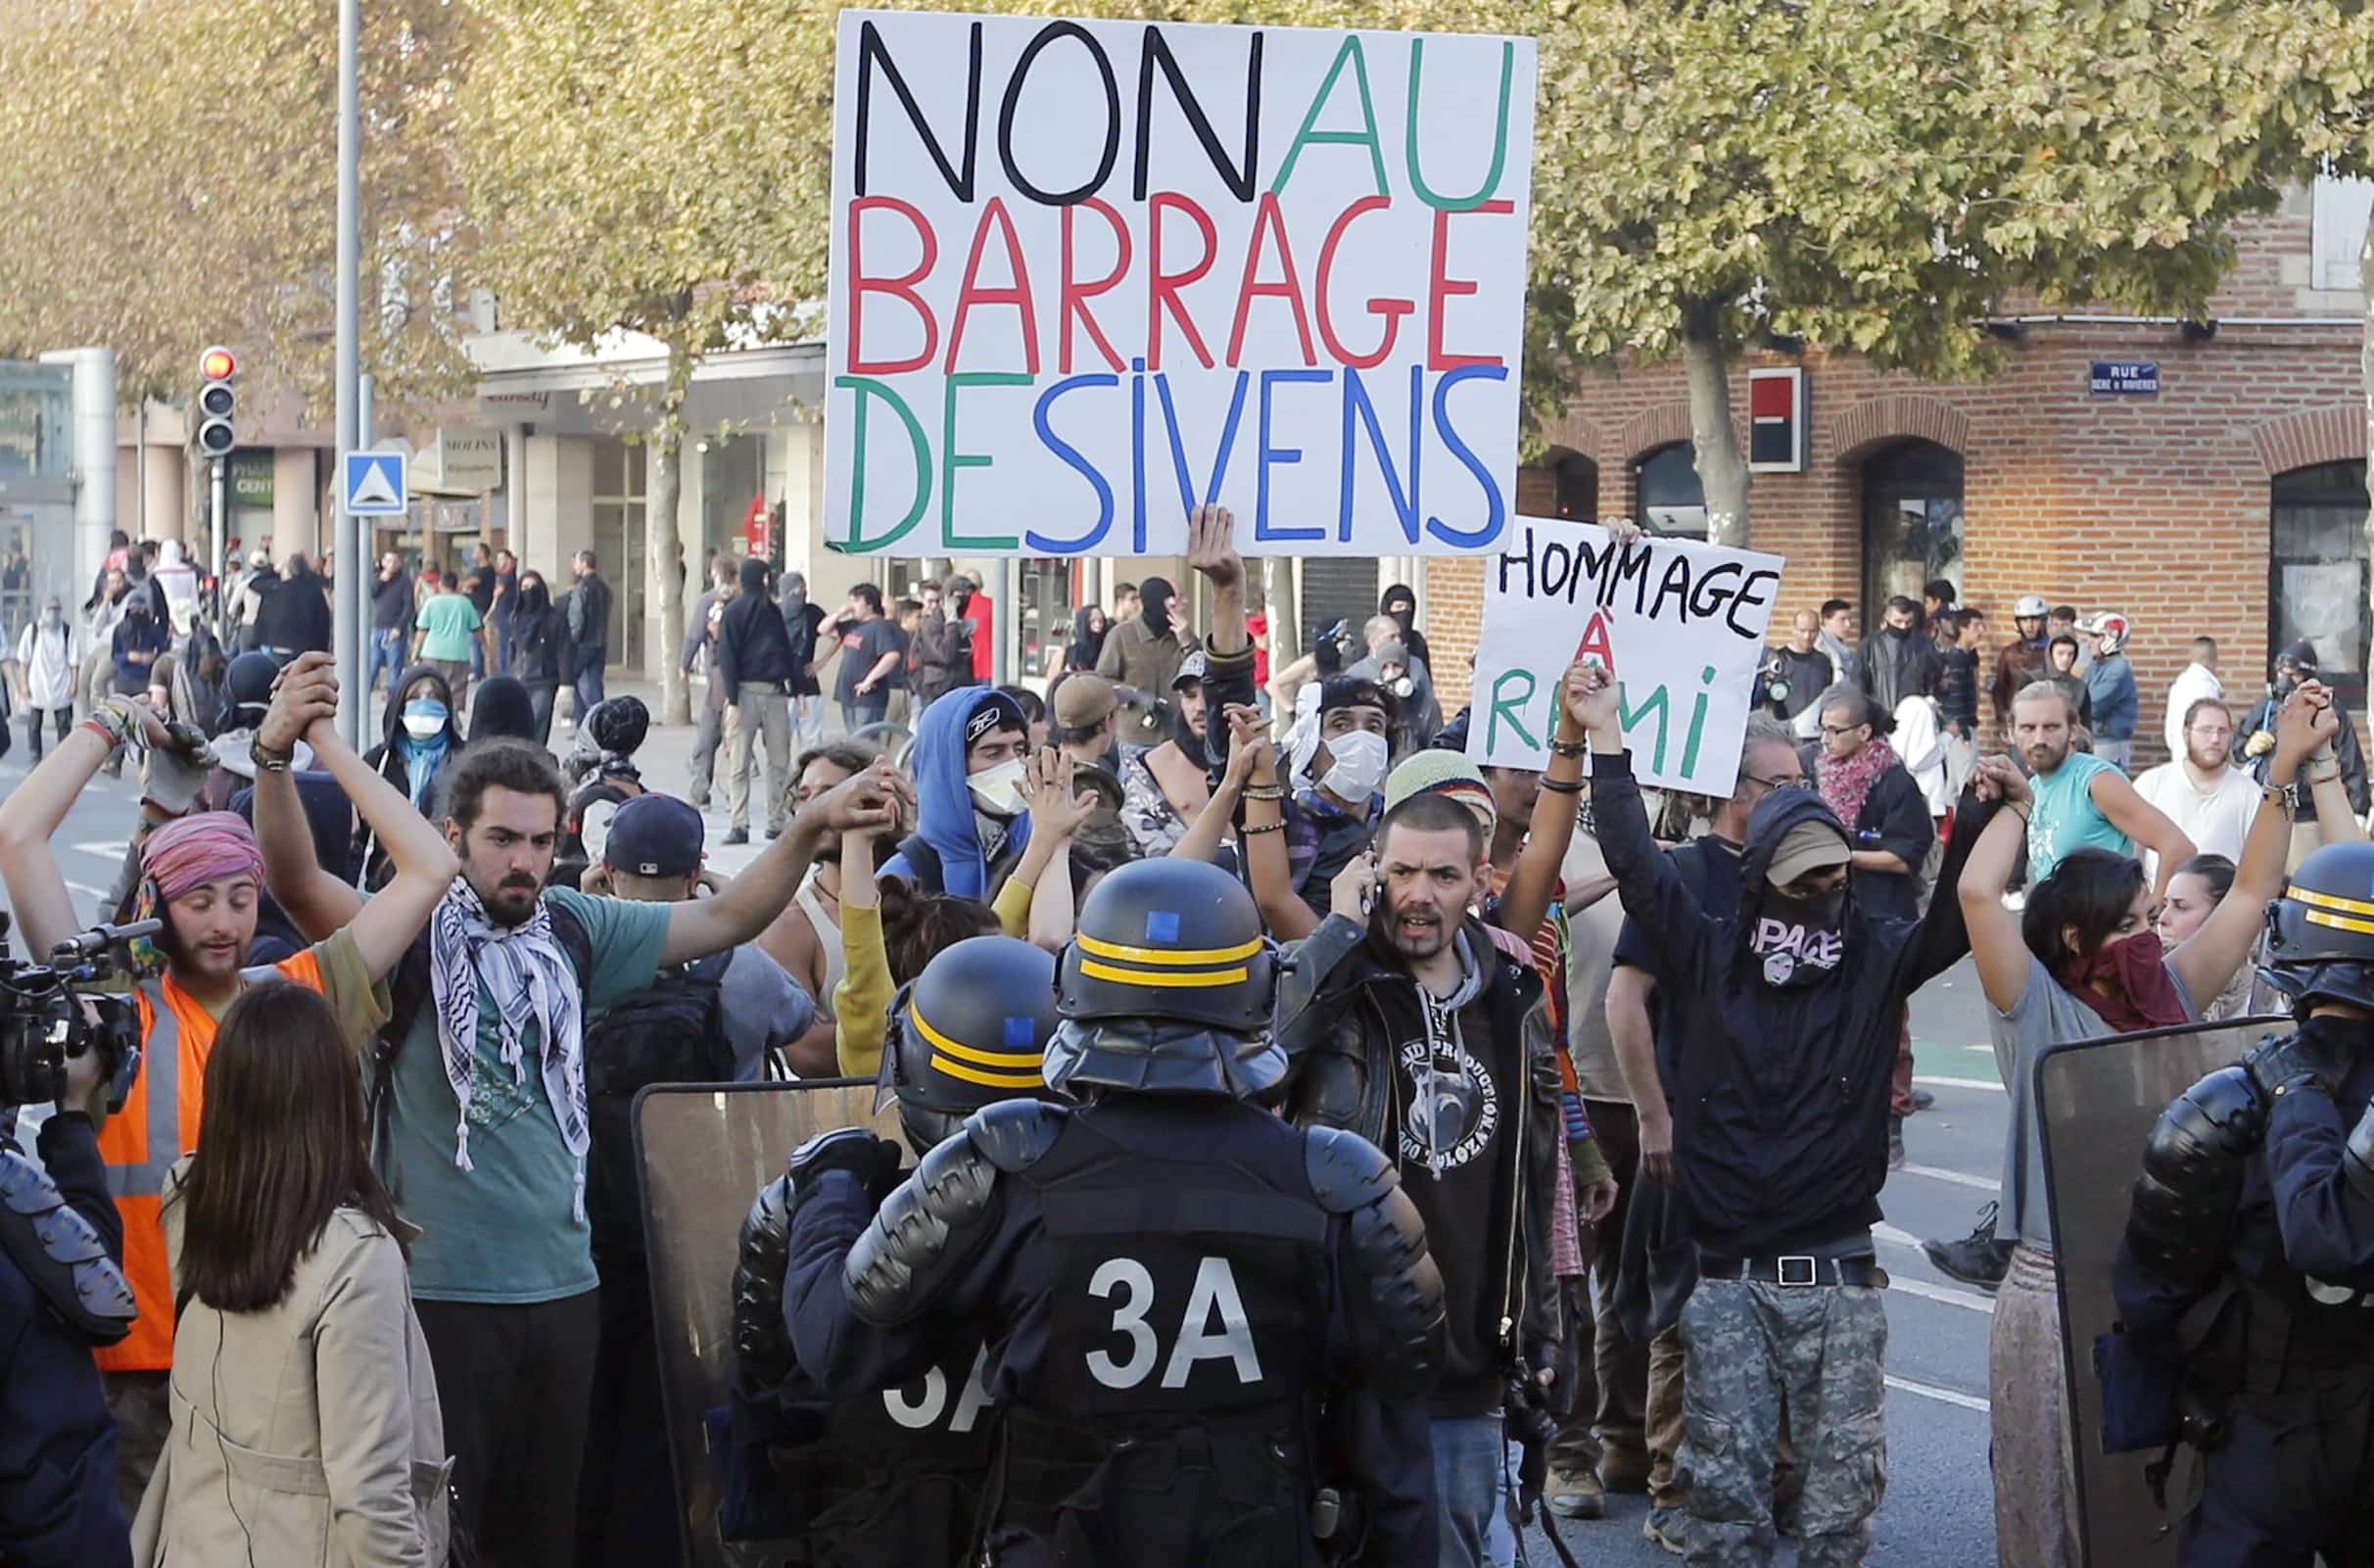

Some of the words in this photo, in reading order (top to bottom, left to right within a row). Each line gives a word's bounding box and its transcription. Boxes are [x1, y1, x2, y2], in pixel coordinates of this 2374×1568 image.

[855, 21, 1263, 206] NON
[1271, 34, 1514, 210] AU
[848, 192, 1514, 374] BARRAGE
[2110, 365, 2140, 378] RUE
[825, 373, 1034, 554] DE
[1499, 528, 1780, 640] HOMMAGE
[1488, 661, 1716, 781] RMi
[1086, 1257, 1264, 1389] 3A
